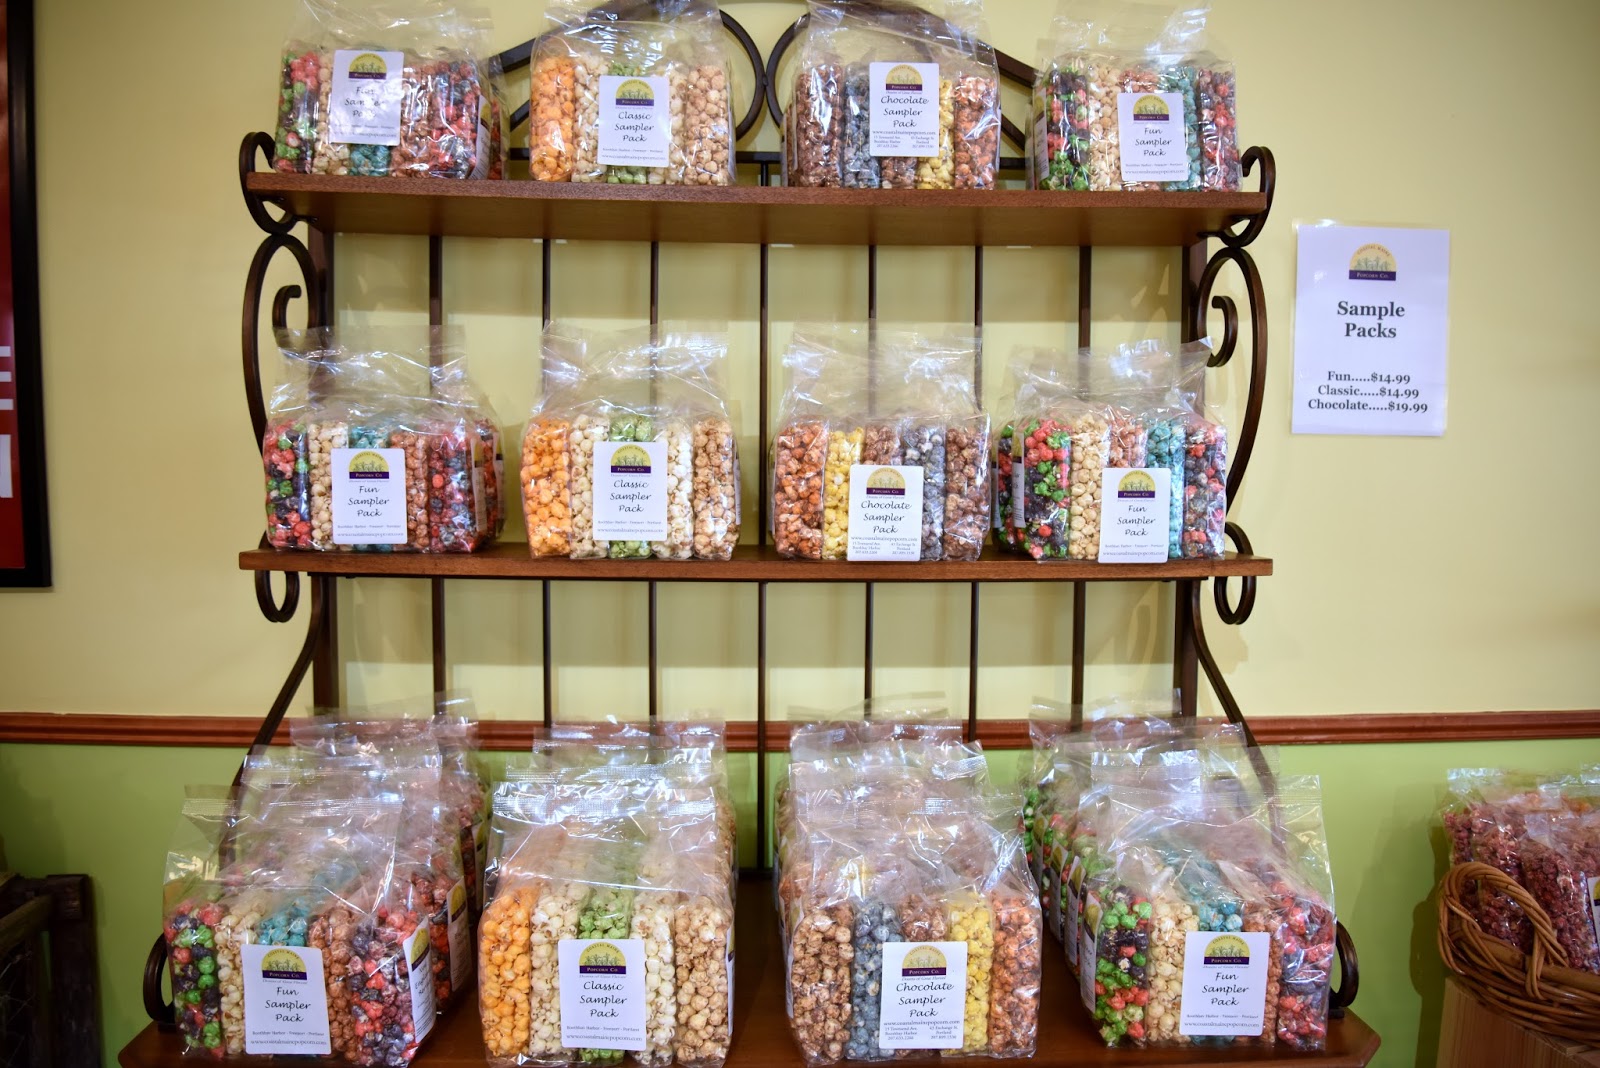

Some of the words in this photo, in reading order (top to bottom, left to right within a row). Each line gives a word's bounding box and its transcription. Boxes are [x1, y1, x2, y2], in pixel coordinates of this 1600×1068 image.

[345, 98, 386, 106] Same
[881, 96, 929, 104] Chocolate
[618, 112, 652, 120] Classic
[883, 108, 922, 118] Sampler
[615, 123, 654, 133] Sampler
[893, 120, 917, 128] Pack
[1135, 138, 1172, 147] Sampler
[1337, 300, 1405, 320] Sample
[1344, 323, 1397, 338] Packs
[614, 480, 649, 488] Classic
[348, 497, 389, 507] Sampler
[610, 492, 651, 502] Sampler
[861, 500, 912, 509] Chocolate
[357, 509, 382, 517] Pack
[863, 513, 904, 523] Sampler
[1117, 516, 1156, 526] Sampler
[873, 525, 898, 533] Pack
[1125, 528, 1149, 536] Pack
[1216, 972, 1239, 981] Fun
[276, 986, 299, 996] Fun
[583, 981, 624, 991] Classic
[896, 982, 954, 992] Chocolate
[1202, 985, 1249, 995] Sampler
[265, 1000, 311, 1011] Sampler
[580, 995, 627, 1007] Sampler
[899, 995, 946, 1006] Sampler
[1211, 997, 1240, 1006] Pack
[275, 1013, 304, 1022] Pack
[590, 1009, 619, 1018] Pack
[910, 1008, 939, 1018] Pack
